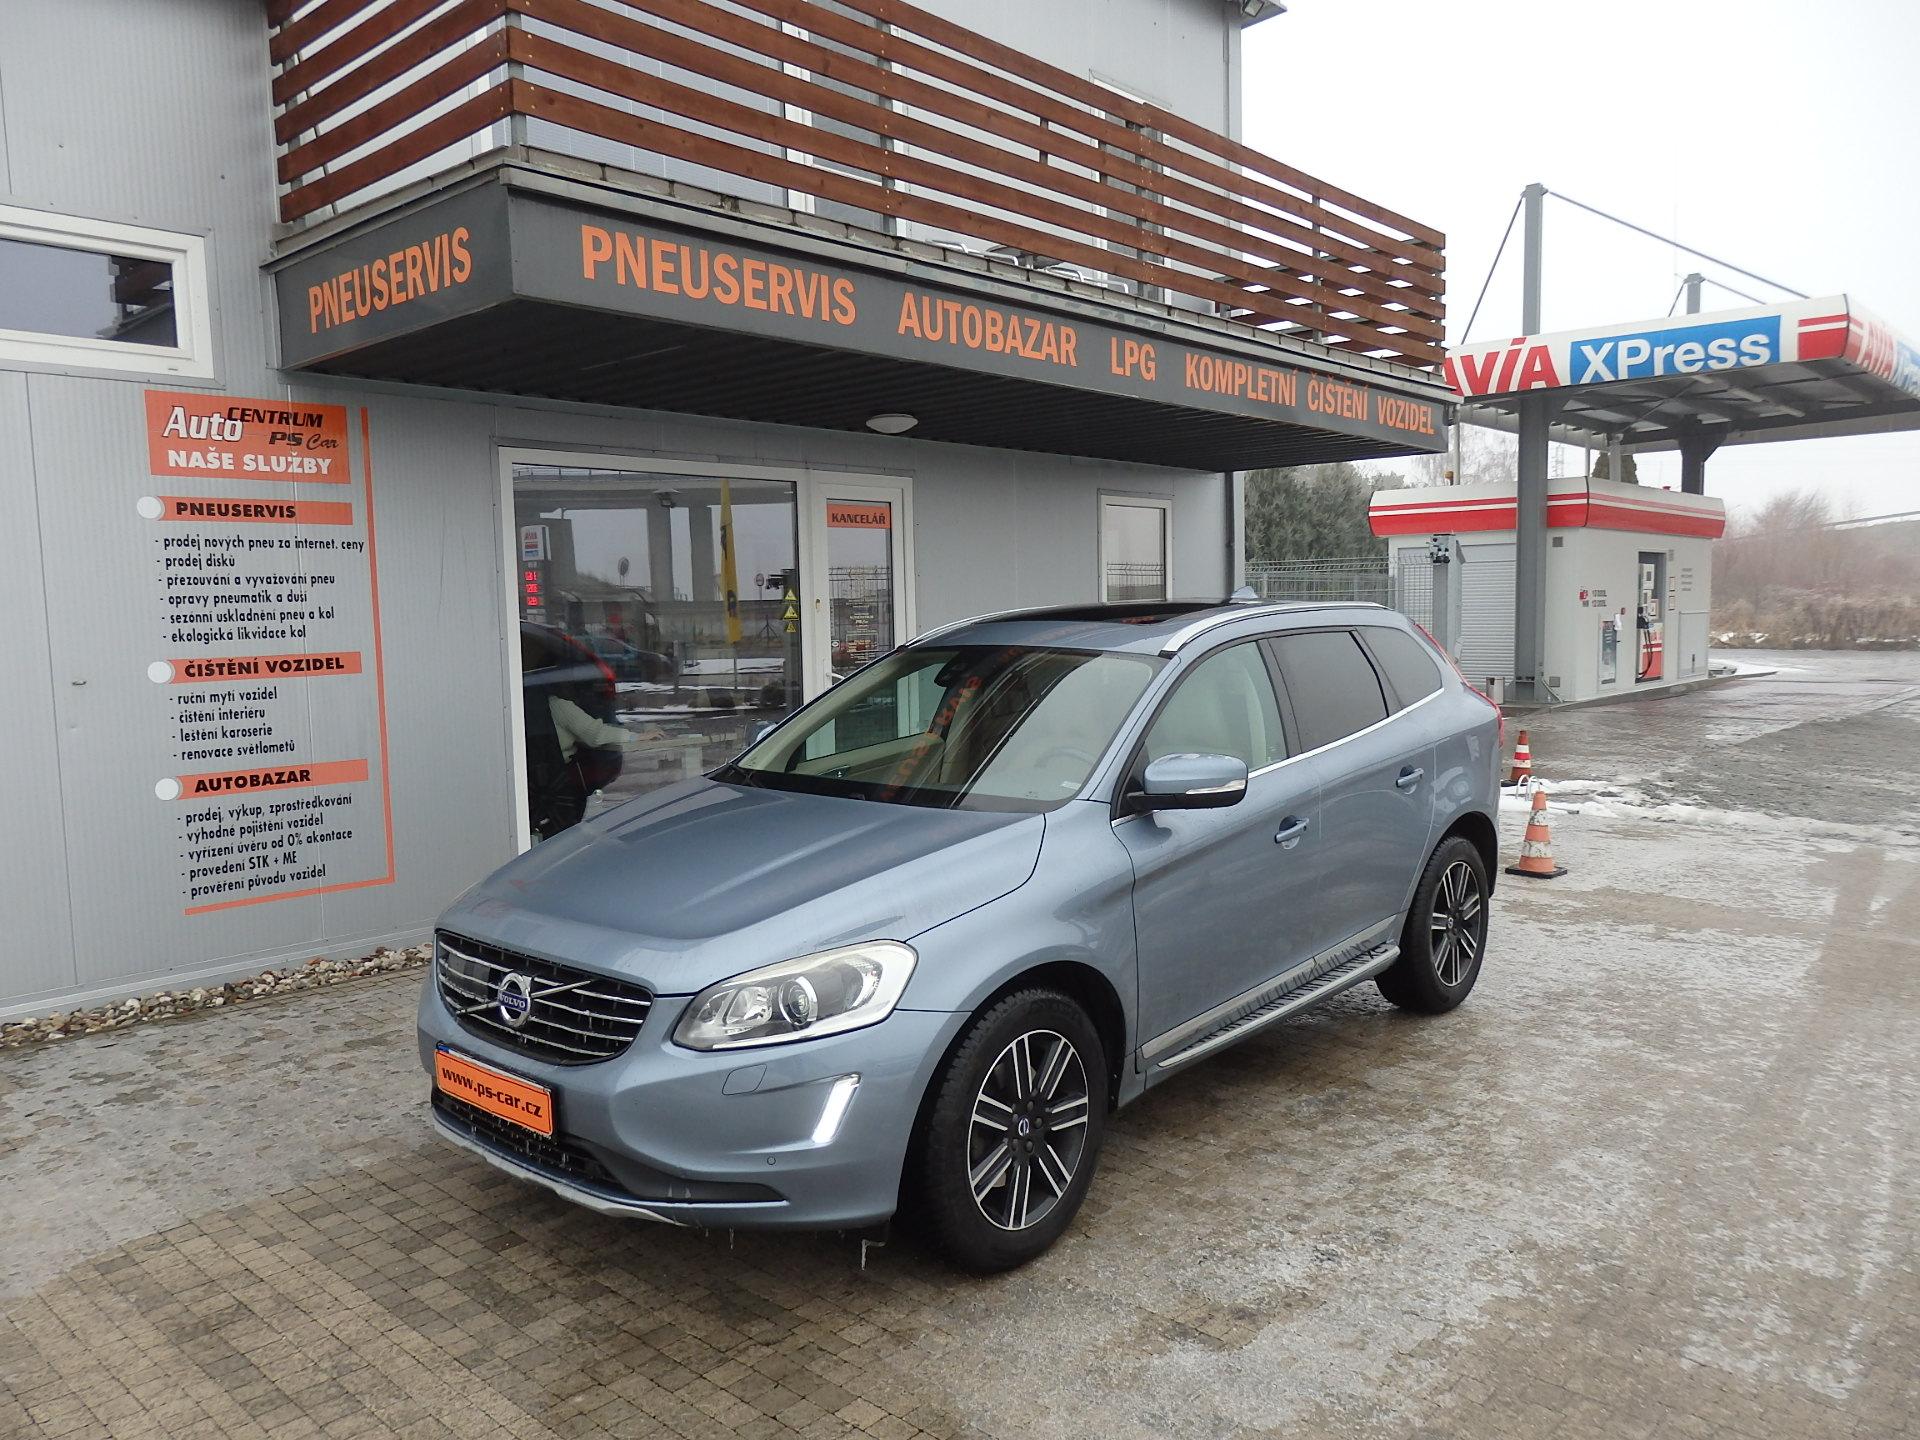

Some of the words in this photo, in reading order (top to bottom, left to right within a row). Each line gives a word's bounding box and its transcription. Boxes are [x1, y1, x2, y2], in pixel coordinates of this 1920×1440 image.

[308, 226, 473, 334] PNEUSERVIS
[580, 224, 857, 326] PNEUSERVIS
[897, 292, 1078, 368] AUTOBAZAR
[1111, 337, 1157, 381] LPG
[1185, 353, 1298, 407] KOMPLETNÍ
[1308, 370, 1368, 421] ČIŠTĚNÍ
[1377, 396, 1435, 435] VOZIDEL
[1580, 334, 1771, 384] XPress
[162, 405, 244, 443] Auto
[227, 407, 324, 427] CENTRUM
[269, 432, 304, 447] PS
[306, 434, 340, 450] Car
[168, 447, 235, 470] NAŠE
[243, 451, 332, 474] SLUŽBY
[176, 502, 296, 518] PNEUSERVIS
[831, 512, 886, 525] KANCELÁŘ
[164, 534, 201, 550] prodej
[205, 534, 244, 551] nových
[249, 540, 274, 551] pneu
[279, 540, 290, 548] za
[295, 536, 338, 549] internet.
[341, 541, 364, 553] ceny
[165, 553, 202, 570] prodej
[206, 553, 235, 567] disků
[167, 573, 230, 589] přezouvání
[234, 576, 241, 585] a
[245, 572, 307, 588] vyvažování
[310, 575, 335, 587] pneu
[168, 595, 209, 608] opravy
[213, 590, 272, 607] pneumatik
[276, 594, 283, 602] a
[287, 589, 307, 602] duší
[170, 611, 213, 624] sezónní
[216, 608, 276, 623] uskladnění
[280, 611, 305, 623] pneu
[308, 611, 315, 620] a
[319, 606, 335, 619] kol
[171, 628, 233, 645] ekologická
[238, 626, 286, 640] likvidace
[290, 625, 306, 638] kol
[184, 658, 259, 677] ČIŠTĚNÍ
[265, 657, 344, 673] VOZIDEL
[177, 691, 206, 704] ruční
[209, 689, 235, 705] mytí
[239, 686, 278, 701] vozidel
[179, 709, 215, 723] čištění
[219, 706, 265, 721] interiéru
[180, 728, 218, 742] leštění
[222, 723, 273, 738] karoserie
[182, 748, 233, 760] renovace
[237, 740, 295, 756] světlometů
[195, 769, 311, 793] AUTOBAZAR
[228, 804, 264, 821] výkup,
[269, 793, 352, 816] zprostředkování
[187, 825, 235, 844] výhodné
[240, 820, 283, 838] pojištění
[287, 812, 324, 829] vozidel
[188, 842, 234, 863] vyřízení
[237, 840, 267, 854] úvěru
[271, 835, 284, 848] od
[288, 832, 303, 847] 0%
[306, 830, 352, 844] akontace
[190, 860, 246, 882] provedení
[249, 855, 270, 870] STK
[282, 851, 297, 865] ME
[191, 877, 244, 900] prověření
[248, 871, 286, 891] původu
[290, 864, 326, 881] vozidel
[500, 993, 526, 1008] VOLVO
[441, 1067, 543, 1118] www.ps-car.cz
